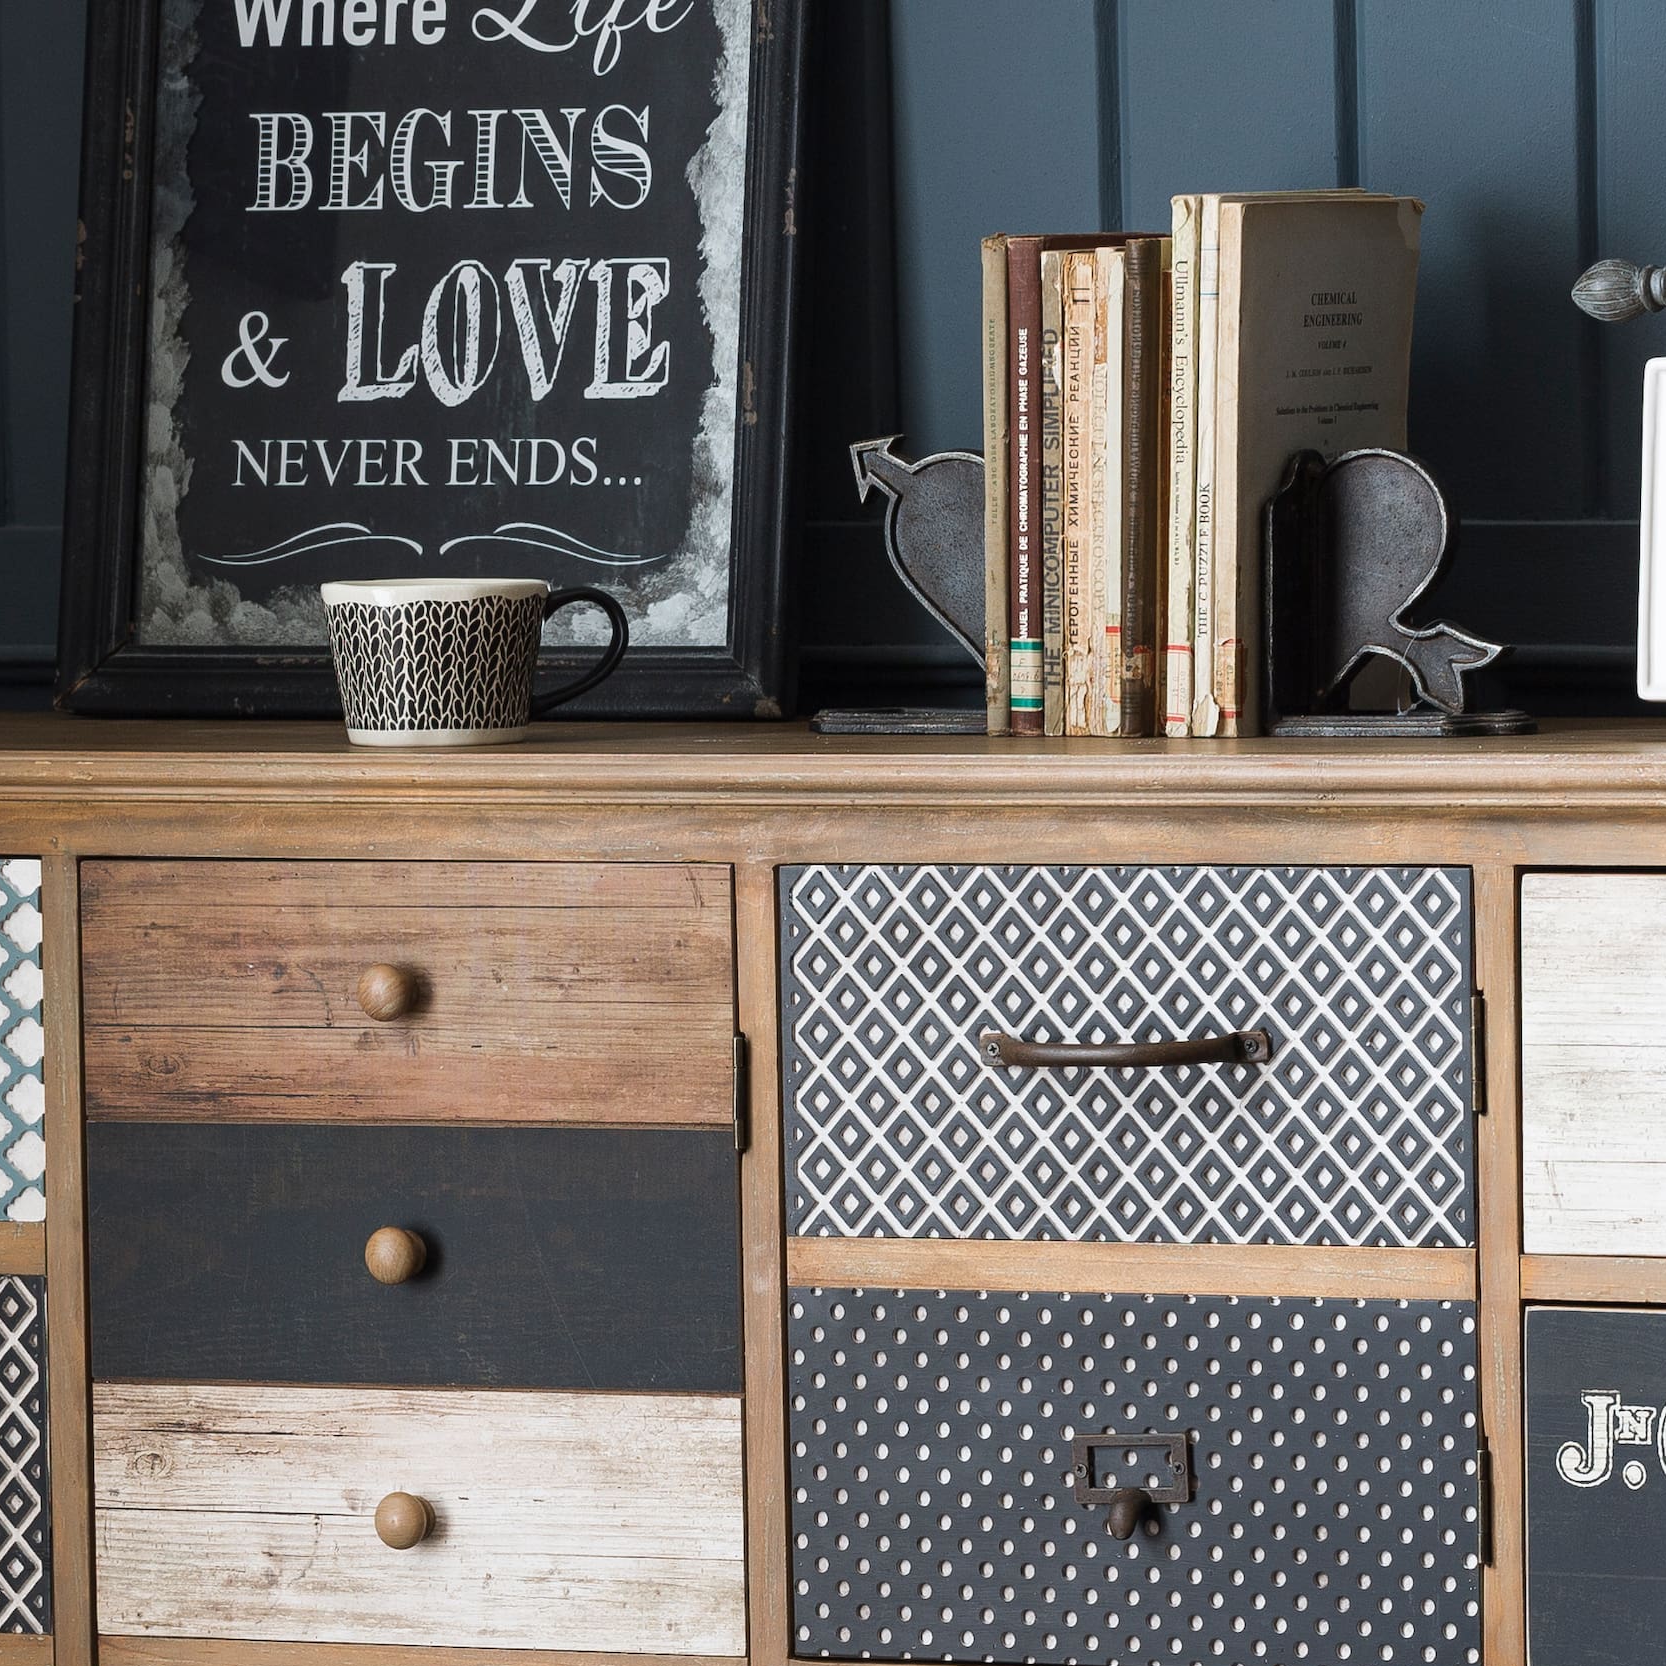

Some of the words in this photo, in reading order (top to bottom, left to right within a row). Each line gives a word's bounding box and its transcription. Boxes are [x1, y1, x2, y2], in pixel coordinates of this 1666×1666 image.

[245, 104, 653, 213] BEGINS
[1175, 260, 1189, 345] Ullmann's
[1303, 312, 1363, 328] ENGINEERING
[1311, 291, 1358, 306] CHEMICAL
[221, 311, 290, 388] &
[337, 257, 671, 407] LOVE
[1018, 327, 1029, 375] GAZEUSE
[1070, 325, 1081, 402] РЕАКЦИИ
[1018, 379, 1029, 412] PHASE
[1042, 328, 1060, 450] SIMPLIFED
[1172, 355, 1188, 464] Encyclopedia
[1018, 415, 1029, 431] EN
[231, 438, 428, 487] NEVER
[445, 437, 642, 487] ENDS...
[1018, 433, 1029, 532] CHROMATOGRAPHIE
[1068, 415, 1079, 527] ХИМИЧЕСКИЕ
[1199, 482, 1211, 524] BOOK
[1019, 536, 1029, 551] DE
[1043, 464, 1061, 634] MINICOMPUTER
[1199, 528, 1209, 588] PUZZLE
[1019, 554, 1030, 604] PRATIQUE
[1200, 592, 1209, 602] C
[1019, 608, 1029, 640] ANUEL
[1197, 607, 1208, 638] THE
[1044, 647, 1062, 690] THE
